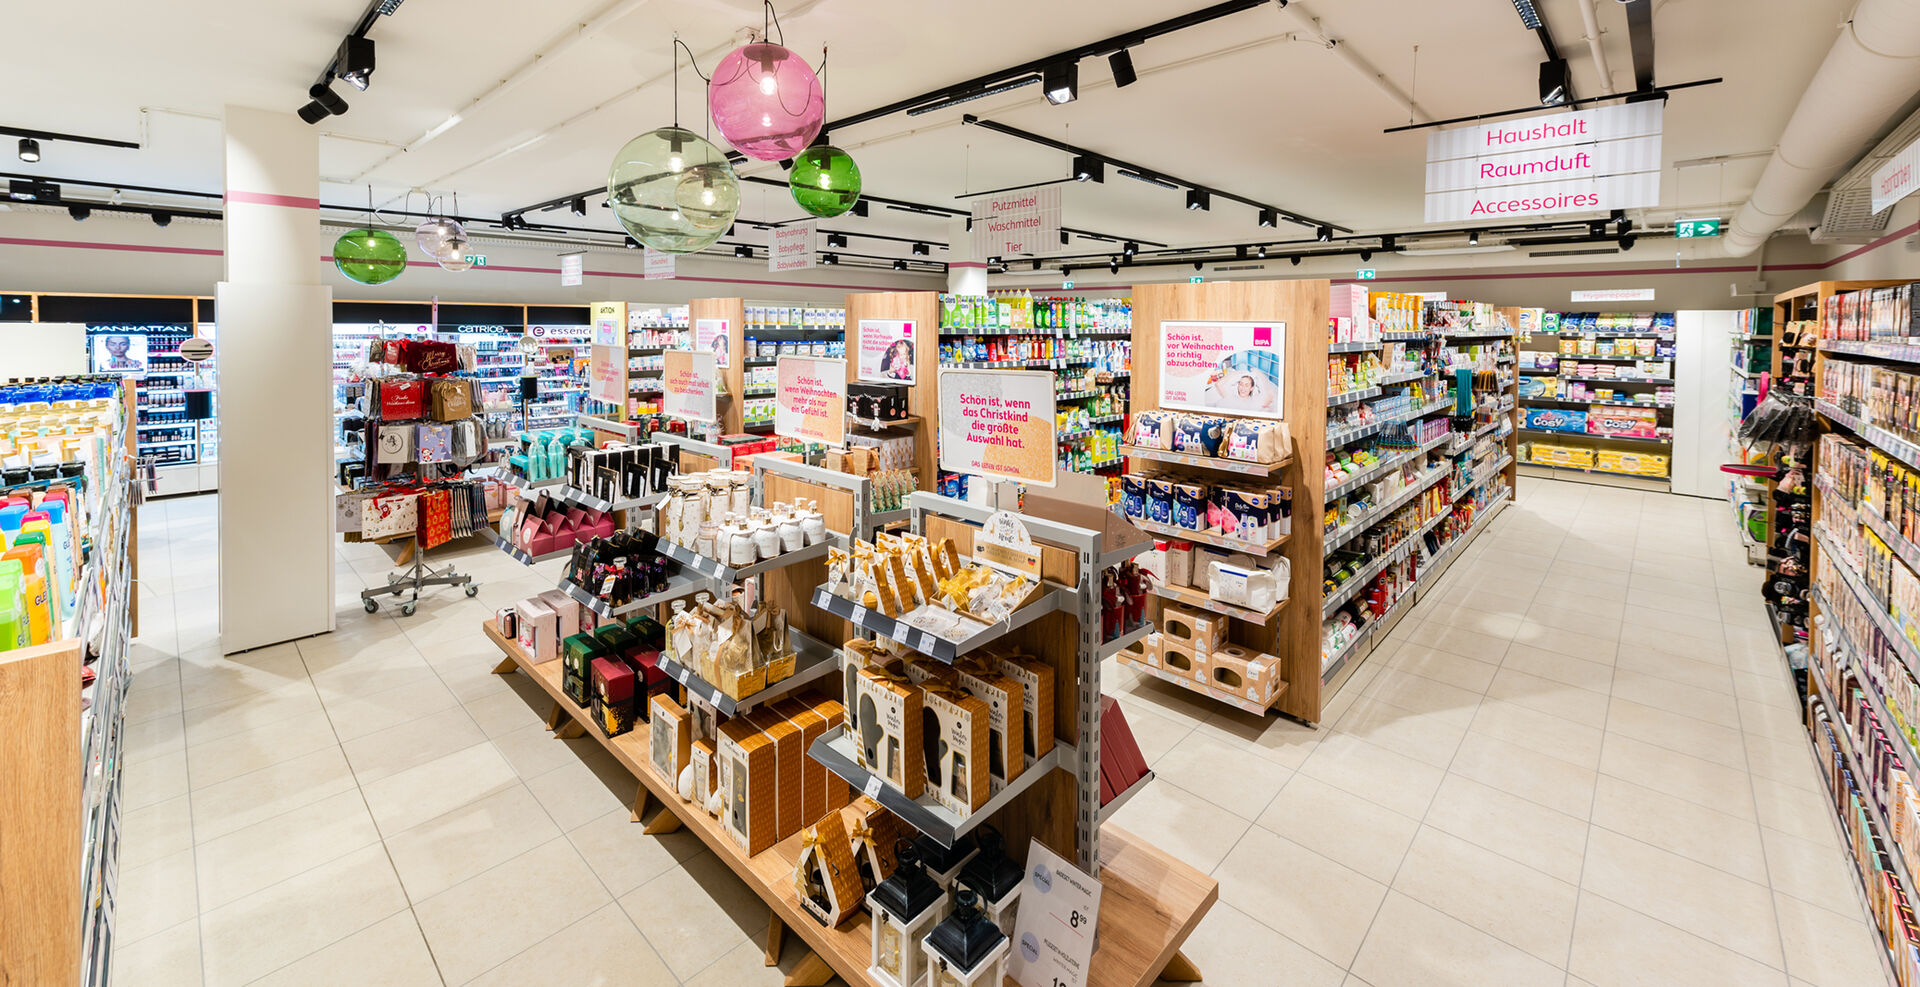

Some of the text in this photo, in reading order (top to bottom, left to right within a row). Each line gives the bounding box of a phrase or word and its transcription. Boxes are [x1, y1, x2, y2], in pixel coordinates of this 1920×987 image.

[1487, 119, 1588, 146] Haushalt
[1480, 152, 1591, 179] Raumduft
[992, 195, 1037, 212] Putzmittel
[1470, 192, 1599, 215] Accessoires
[987, 215, 1041, 232] Waschmittel
[1005, 241, 1022, 252] Tier
[1167, 333, 1191, 341] Schön
[1181, 342, 1234, 351] Weihnachten
[1176, 351, 1202, 361] richtig
[1166, 359, 1221, 369] abzuschalten.
[797, 375, 814, 386] Schön
[800, 386, 837, 398] Weihnachten
[960, 393, 1031, 409] Schön ist, wenn
[791, 405, 800, 413] ein
[800, 405, 819, 416] Gefühl
[962, 407, 1028, 422] das Christkind
[971, 420, 1019, 435] die größte
[966, 432, 1025, 449] Auswahl hat.
[1034, 871, 1050, 887] SPECIAL
[1021, 939, 1038, 956] SPECIAL
